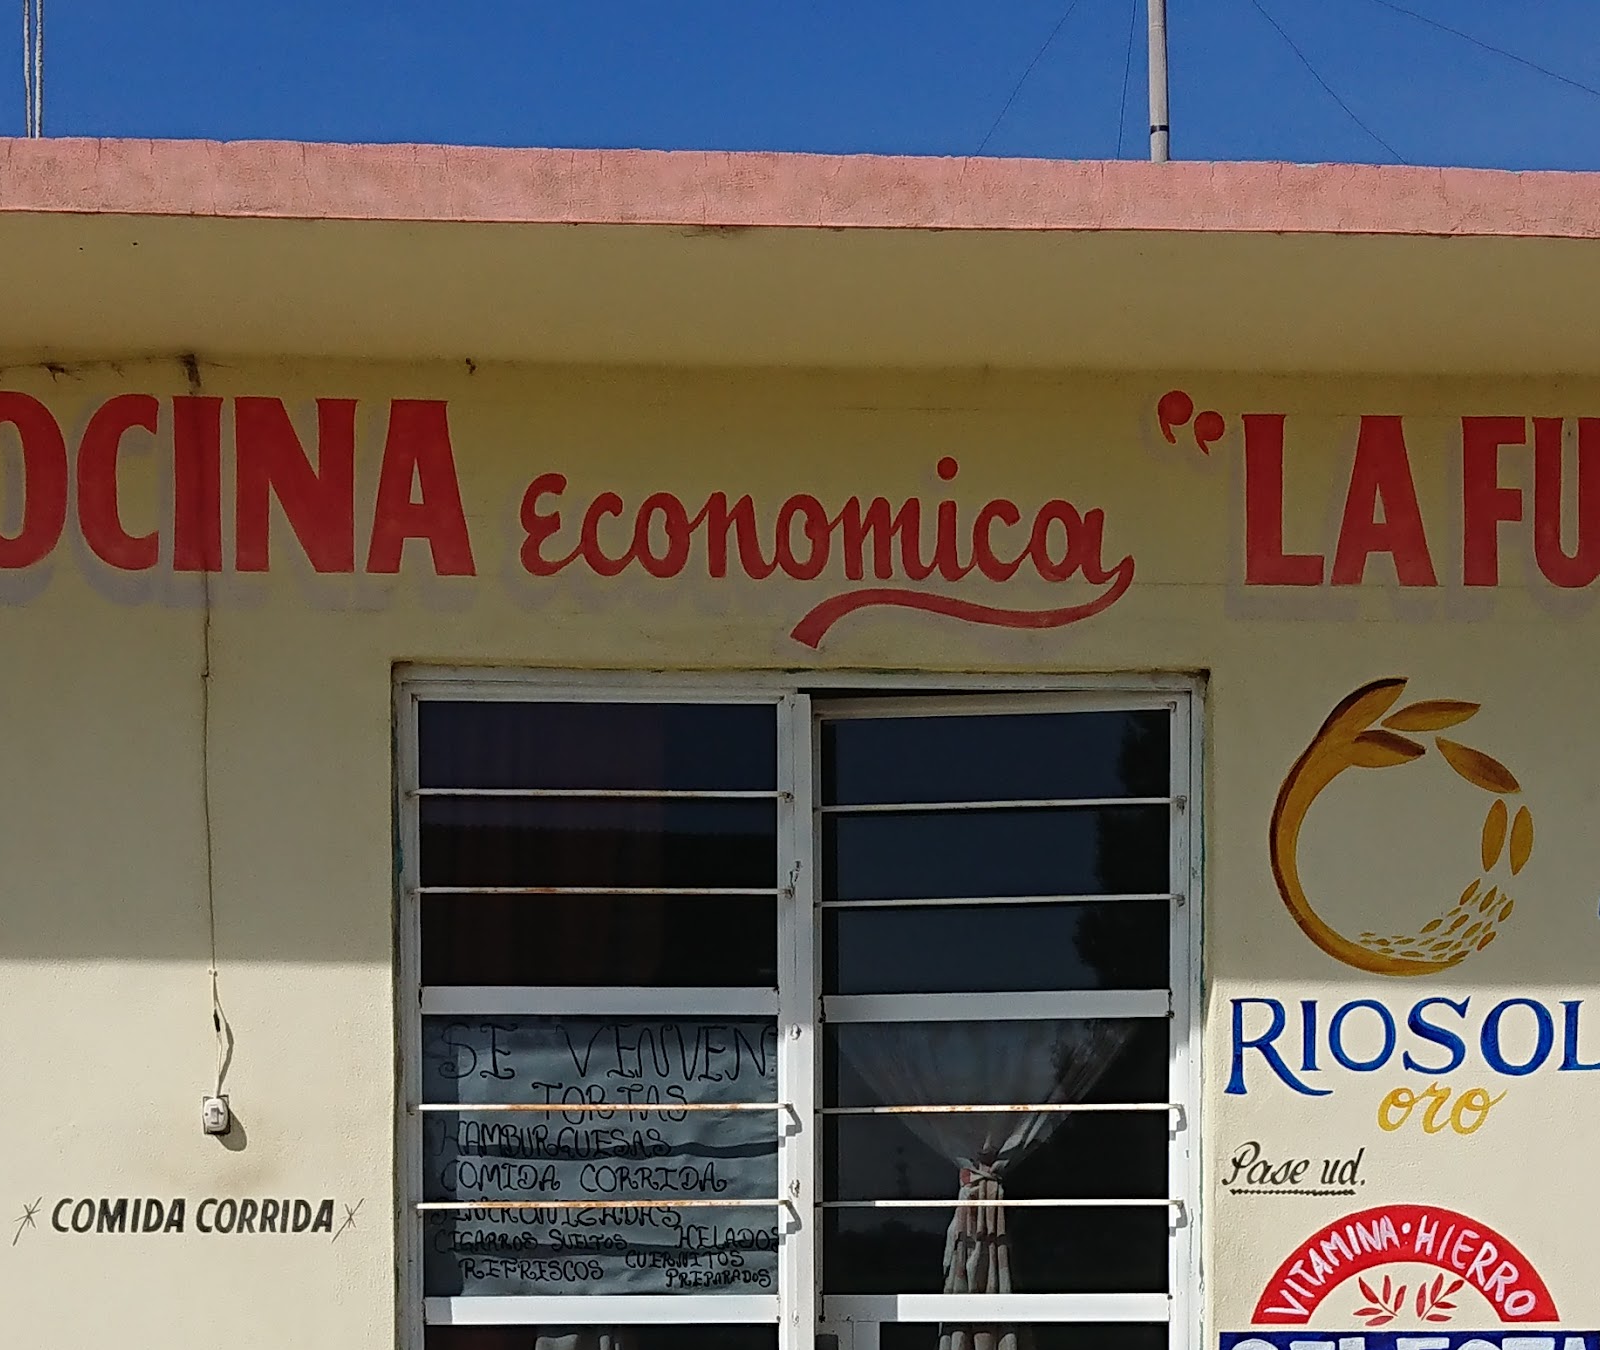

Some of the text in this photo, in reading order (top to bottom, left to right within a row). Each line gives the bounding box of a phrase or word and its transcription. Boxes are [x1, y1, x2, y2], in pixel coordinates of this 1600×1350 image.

[518, 456, 1135, 650] Economica
[438, 1022, 518, 1079] SE
[532, 1082, 689, 1125] TORTAS
[1378, 1081, 1507, 1135] oro
[431, 1119, 672, 1159] HAMBURGUESAS
[441, 1159, 728, 1192] COMIDA CORRIDA
[1221, 1141, 1310, 1186] Pase
[51, 1198, 335, 1233] COMIDA CORRIDA
[434, 1229, 539, 1254] CIGARROS
[458, 1250, 745, 1282] REFRESCOS CUERNITOS
[666, 1268, 771, 1288] PREPARADOS
[1263, 1215, 1537, 1316] VITAMINA HIERRO
